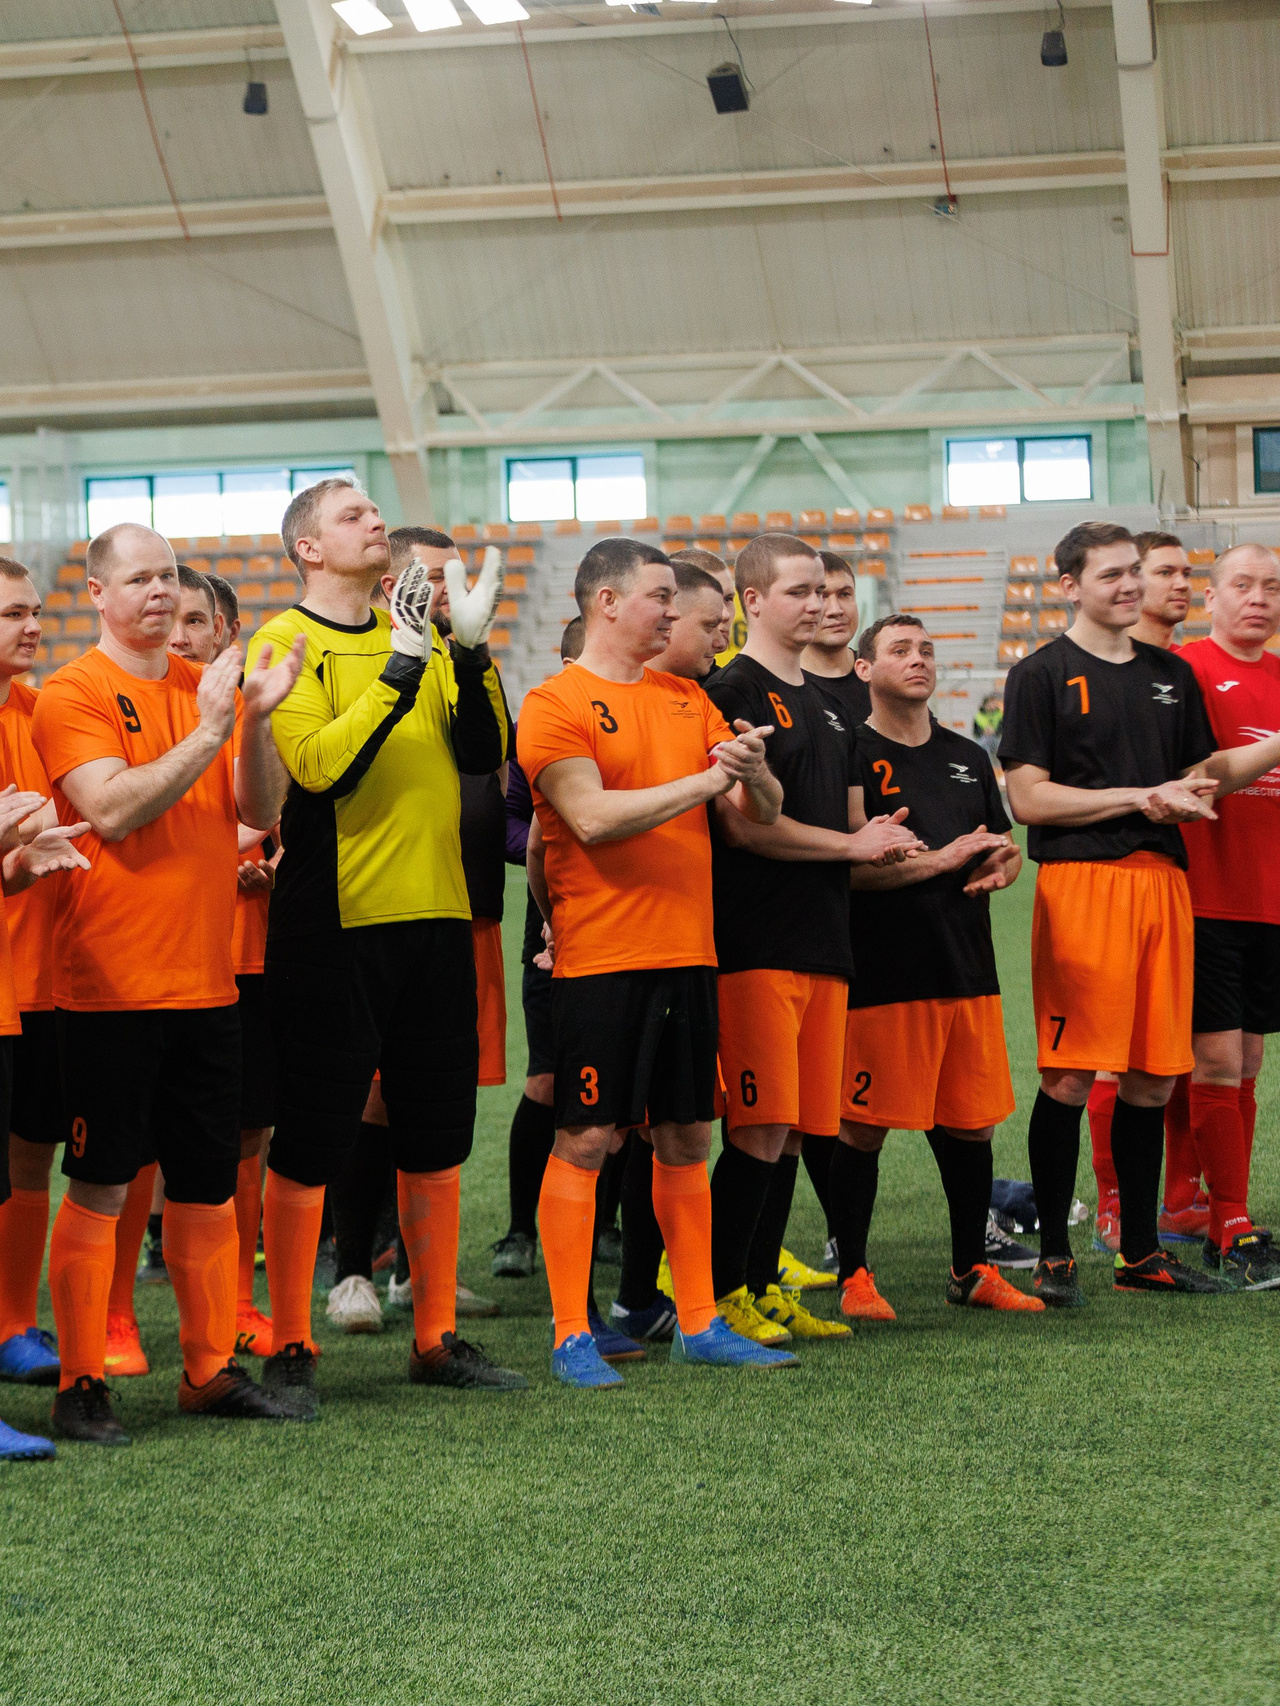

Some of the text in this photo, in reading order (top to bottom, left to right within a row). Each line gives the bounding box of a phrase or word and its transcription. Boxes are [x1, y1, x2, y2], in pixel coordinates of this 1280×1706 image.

[117, 693, 142, 733] 9
[768, 692, 793, 729] 6
[1066, 675, 1090, 715] 7
[591, 700, 619, 734] 3
[872, 759, 901, 796] 2
[1050, 1016, 1066, 1051] 7
[579, 1066, 599, 1106] 3
[740, 1070, 758, 1107] 6
[852, 1071, 872, 1106] 2
[72, 1116, 87, 1158] 9
